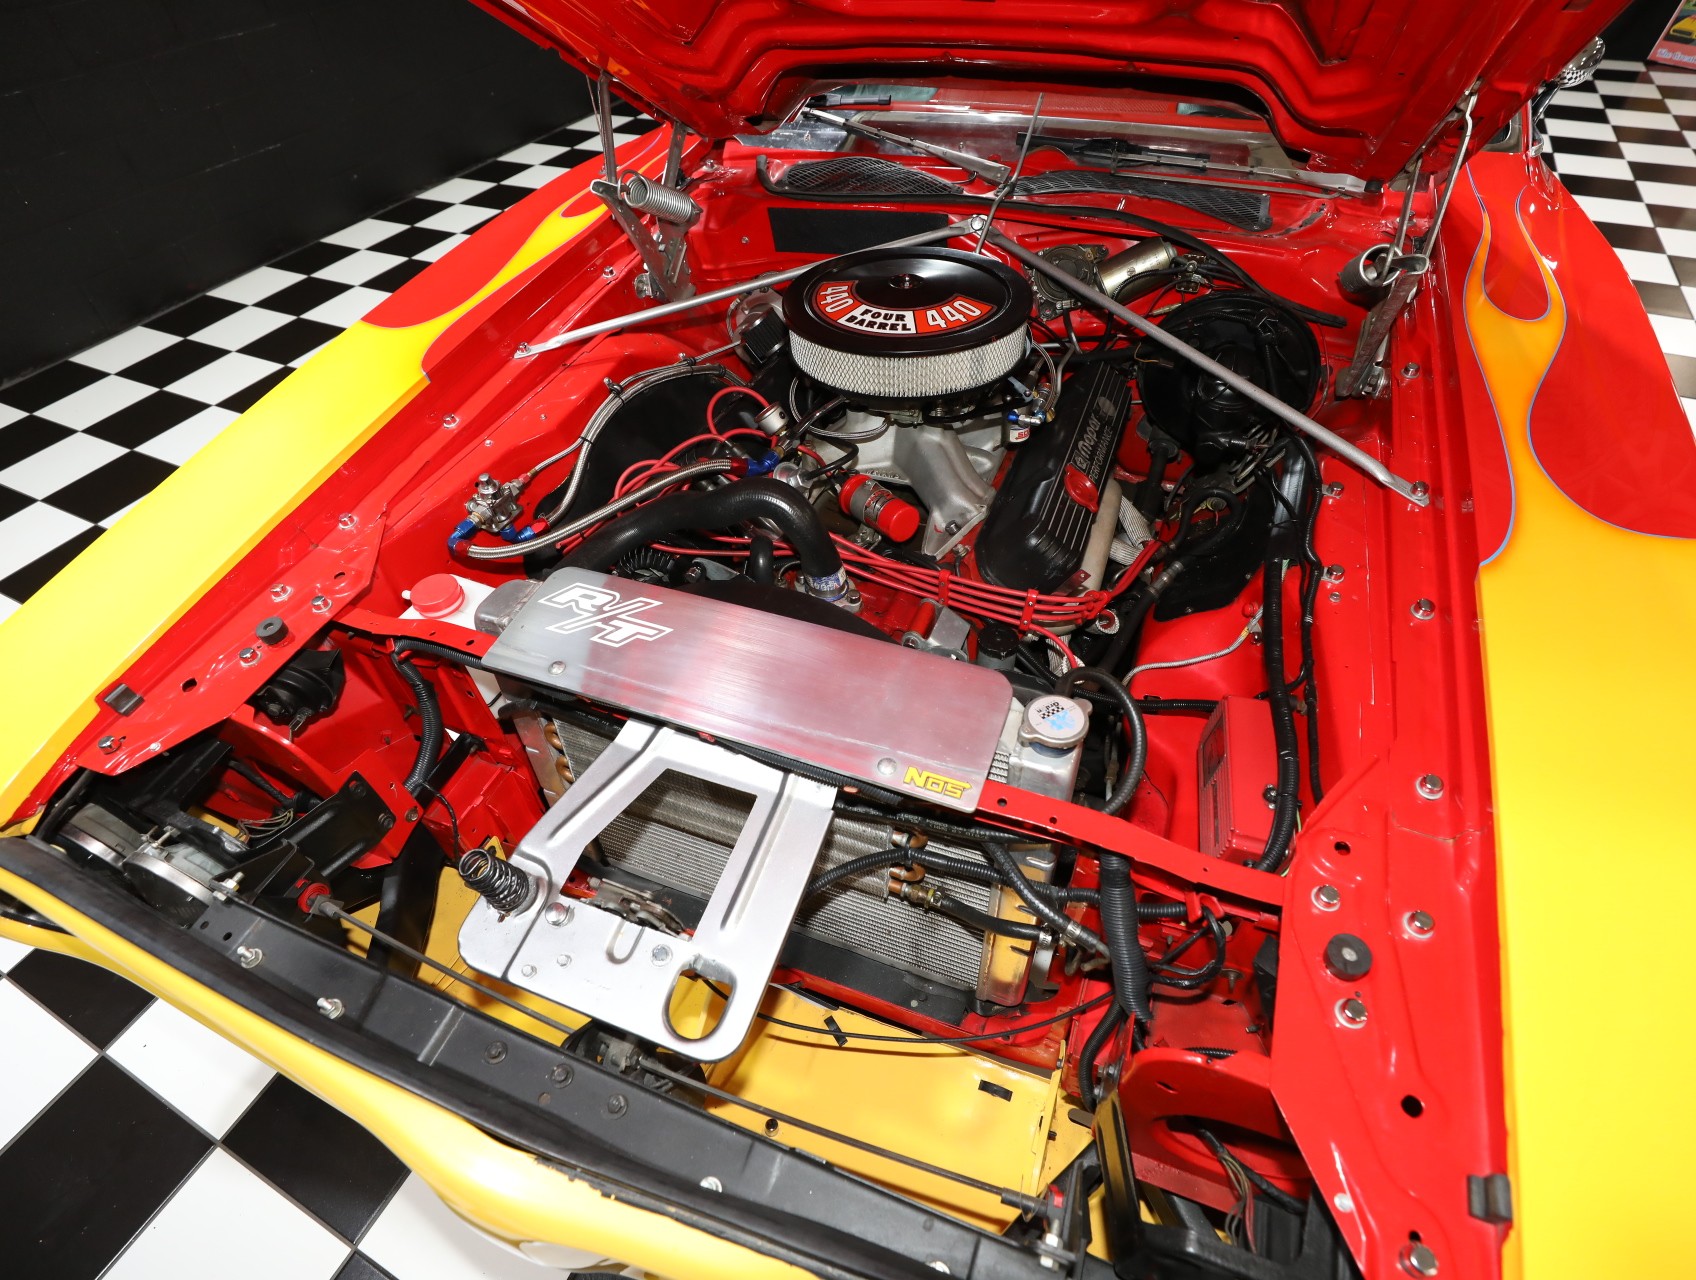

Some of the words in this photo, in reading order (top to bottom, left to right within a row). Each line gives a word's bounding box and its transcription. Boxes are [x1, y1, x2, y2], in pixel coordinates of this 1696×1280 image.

[820, 285, 854, 313] 440
[844, 314, 912, 332] BARREL
[859, 308, 907, 322] FOUR
[926, 300, 982, 329] 440
[1088, 425, 1113, 484] PERFORMANCE
[537, 582, 674, 648] R/T
[903, 765, 972, 800] NOS
